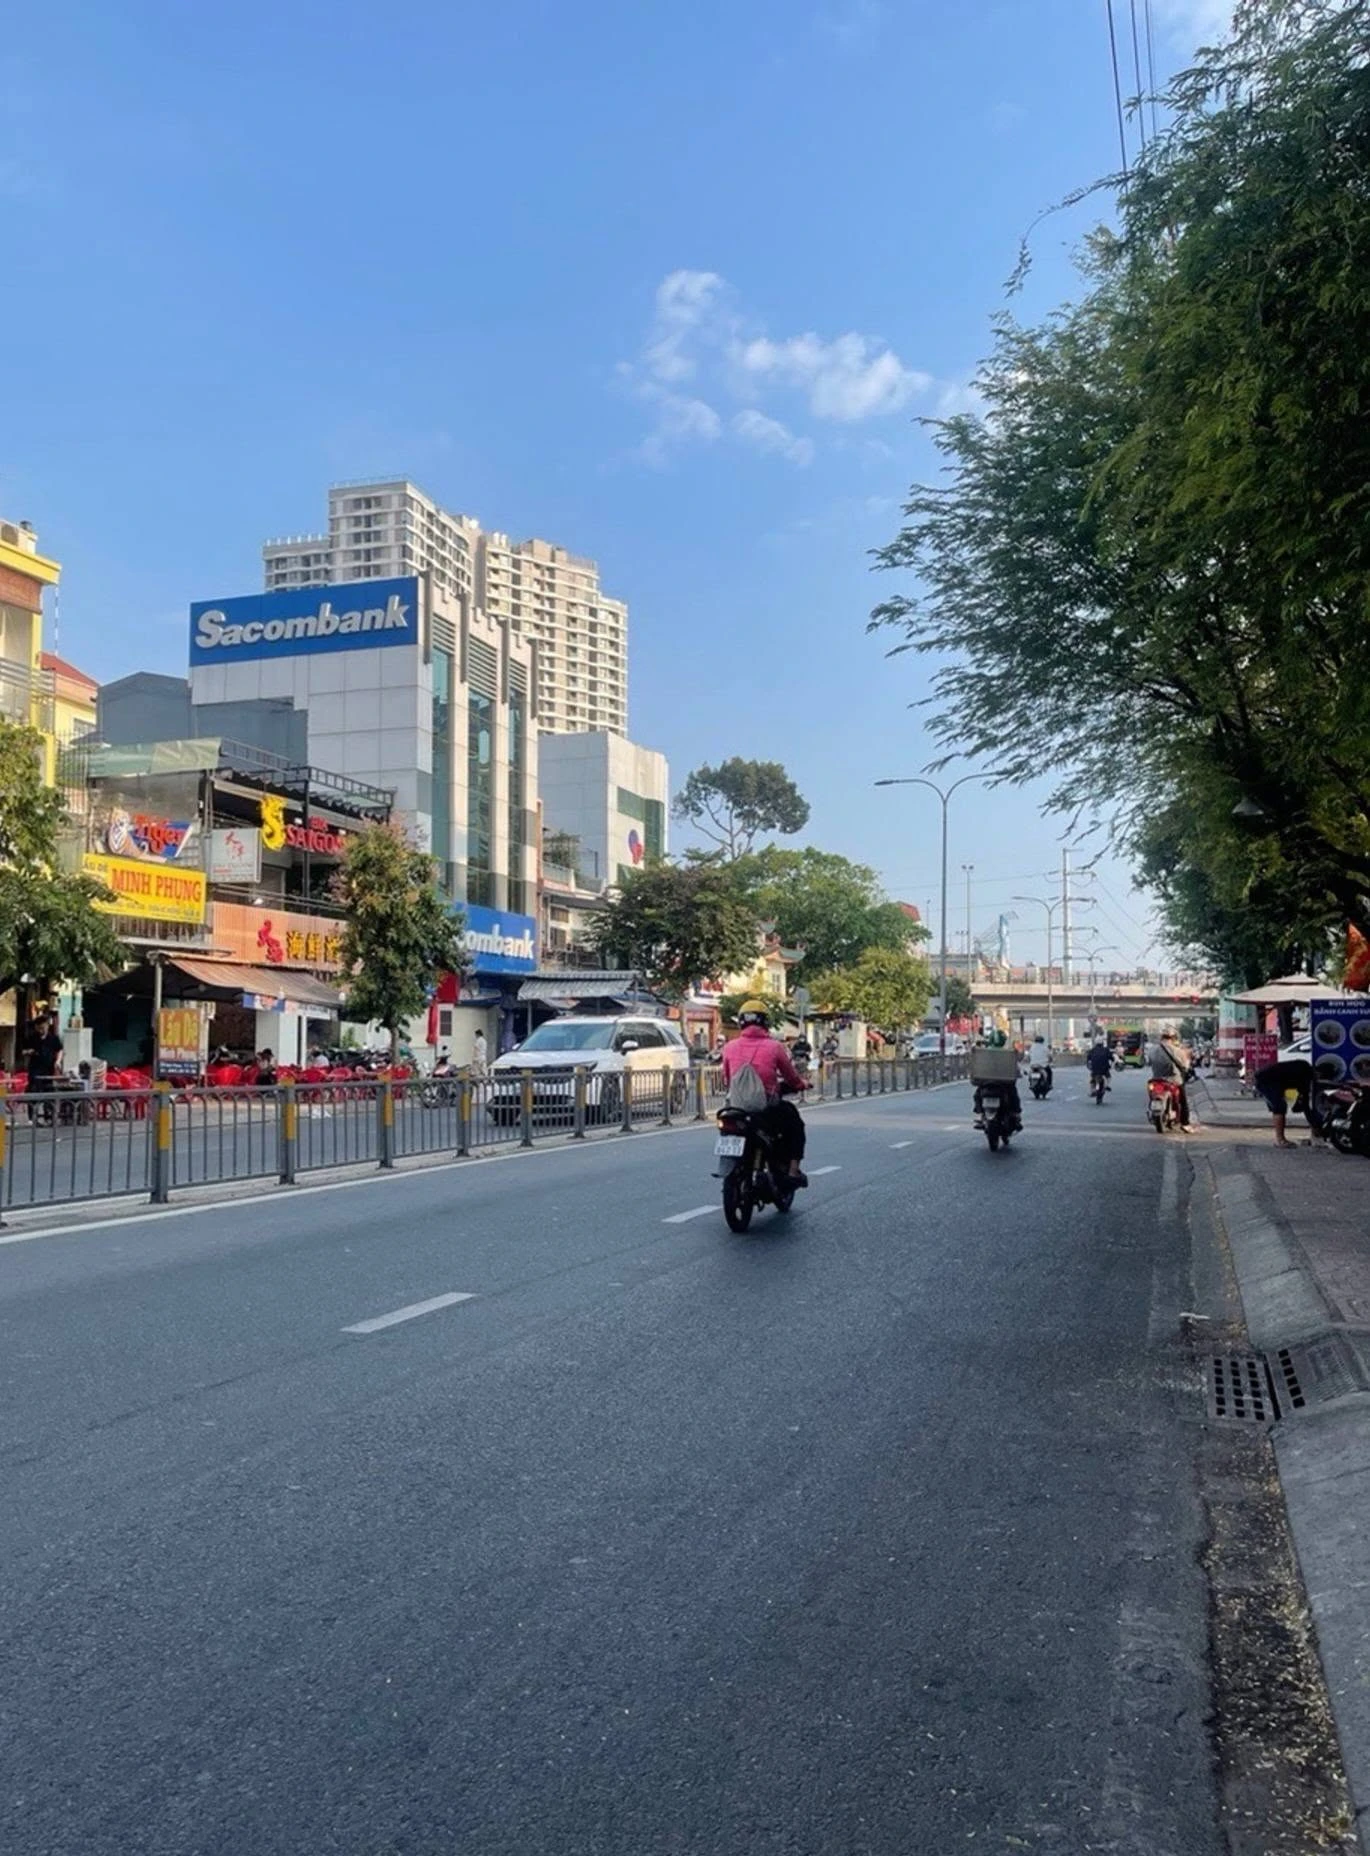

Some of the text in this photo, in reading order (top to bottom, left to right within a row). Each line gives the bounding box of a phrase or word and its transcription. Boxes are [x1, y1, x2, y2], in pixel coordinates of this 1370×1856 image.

[195, 594, 410, 648] Sacombank
[134, 812, 187, 854] Tiger
[111, 868, 202, 906] MINH PHỤNG
